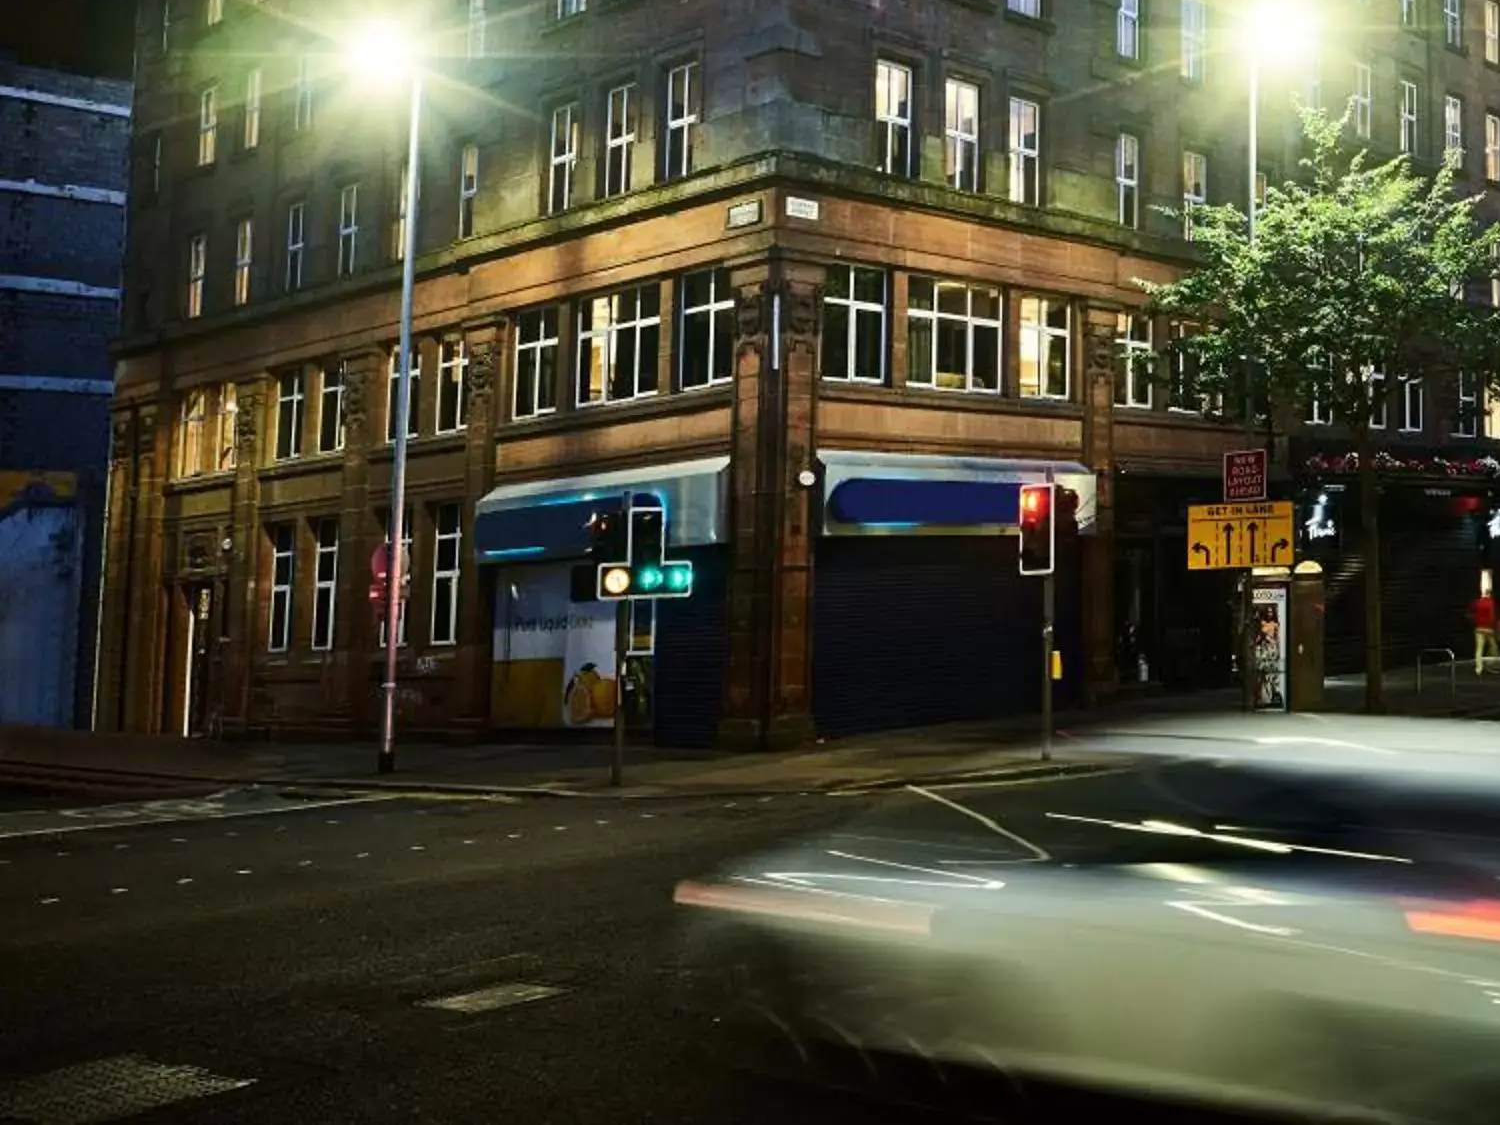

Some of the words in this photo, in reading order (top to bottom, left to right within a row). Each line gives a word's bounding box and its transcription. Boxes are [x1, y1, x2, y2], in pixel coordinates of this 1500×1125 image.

[1207, 506, 1227, 516] GET
[1231, 506, 1243, 515] IN
[1245, 504, 1274, 515] LANE
